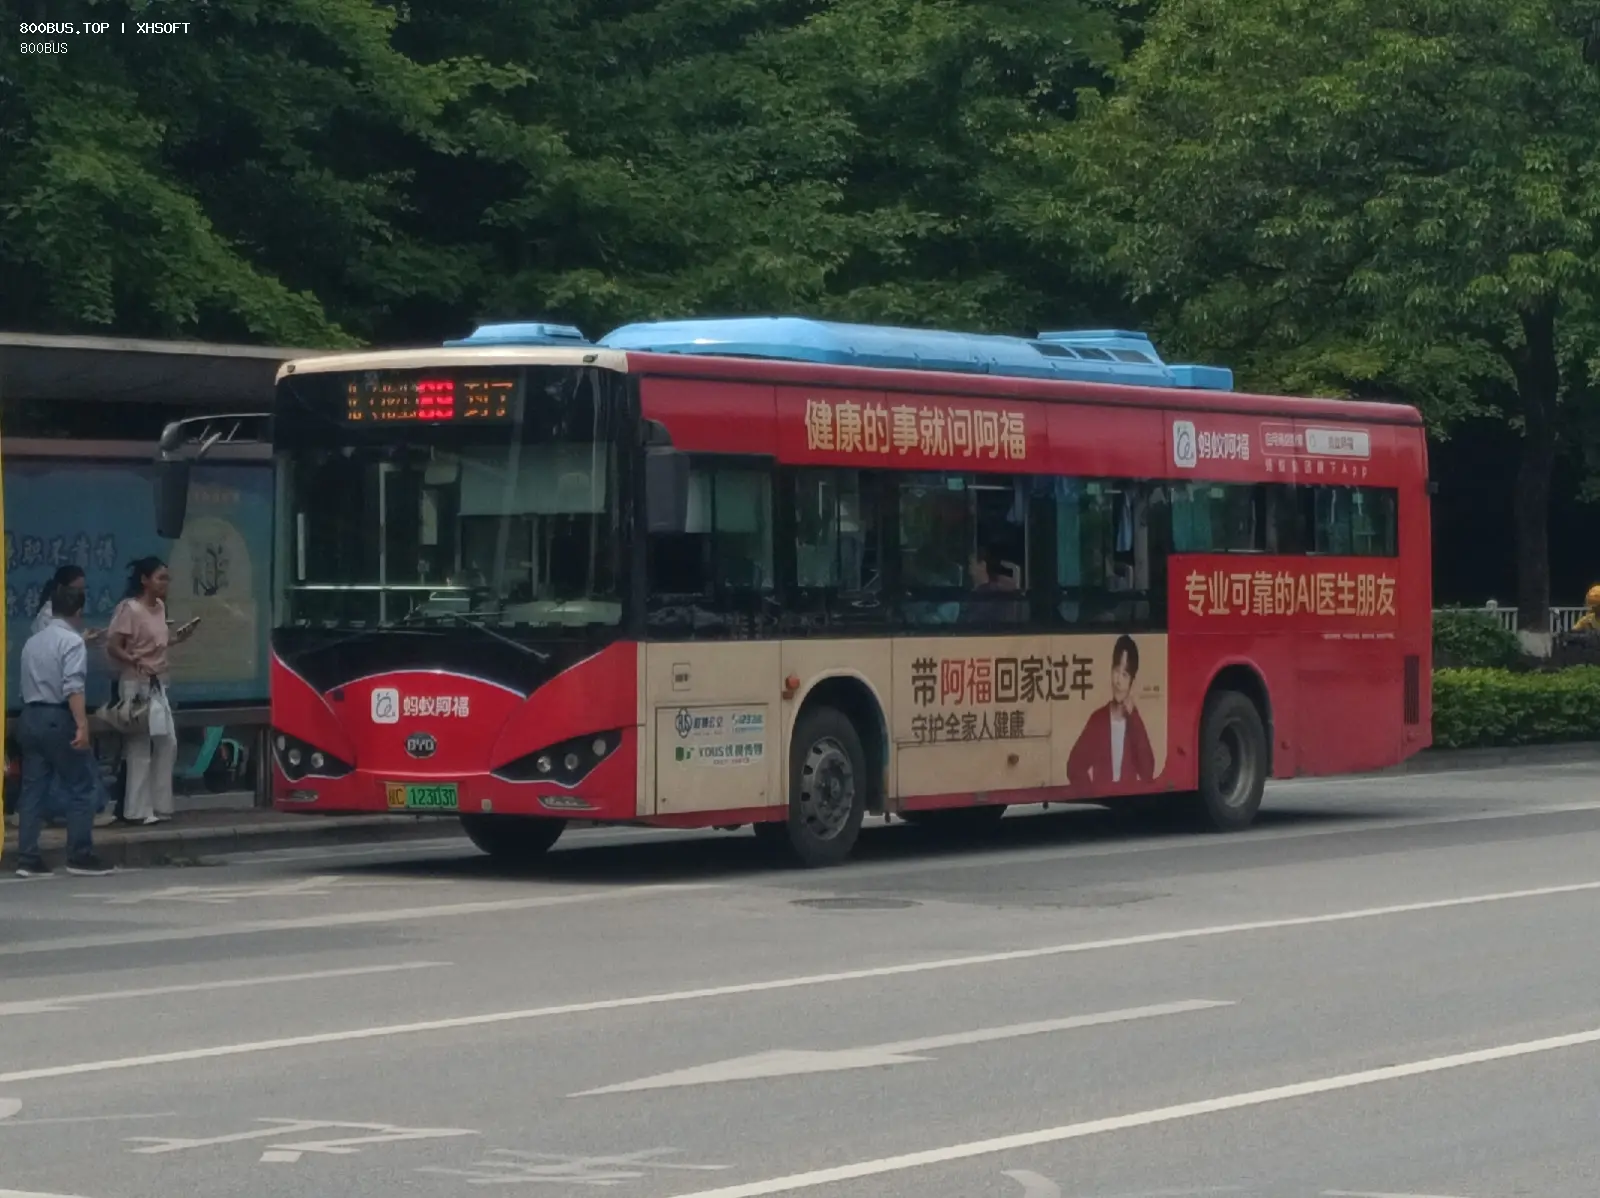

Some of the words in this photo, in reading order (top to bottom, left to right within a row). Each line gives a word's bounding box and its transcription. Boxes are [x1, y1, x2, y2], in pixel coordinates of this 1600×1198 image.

[805, 398, 1026, 460] 健康的事就问阿福
[1198, 431, 1250, 461] 蚂蚁阿福
[1185, 569, 1396, 617] 专业可靠的AI医生朋友
[911, 654, 1094, 708] 带阿福回家过年
[403, 695, 470, 718] 蚂蚁阿福
[911, 710, 1026, 743] 守护全家人健康
[407, 739, 435, 752] BYD
